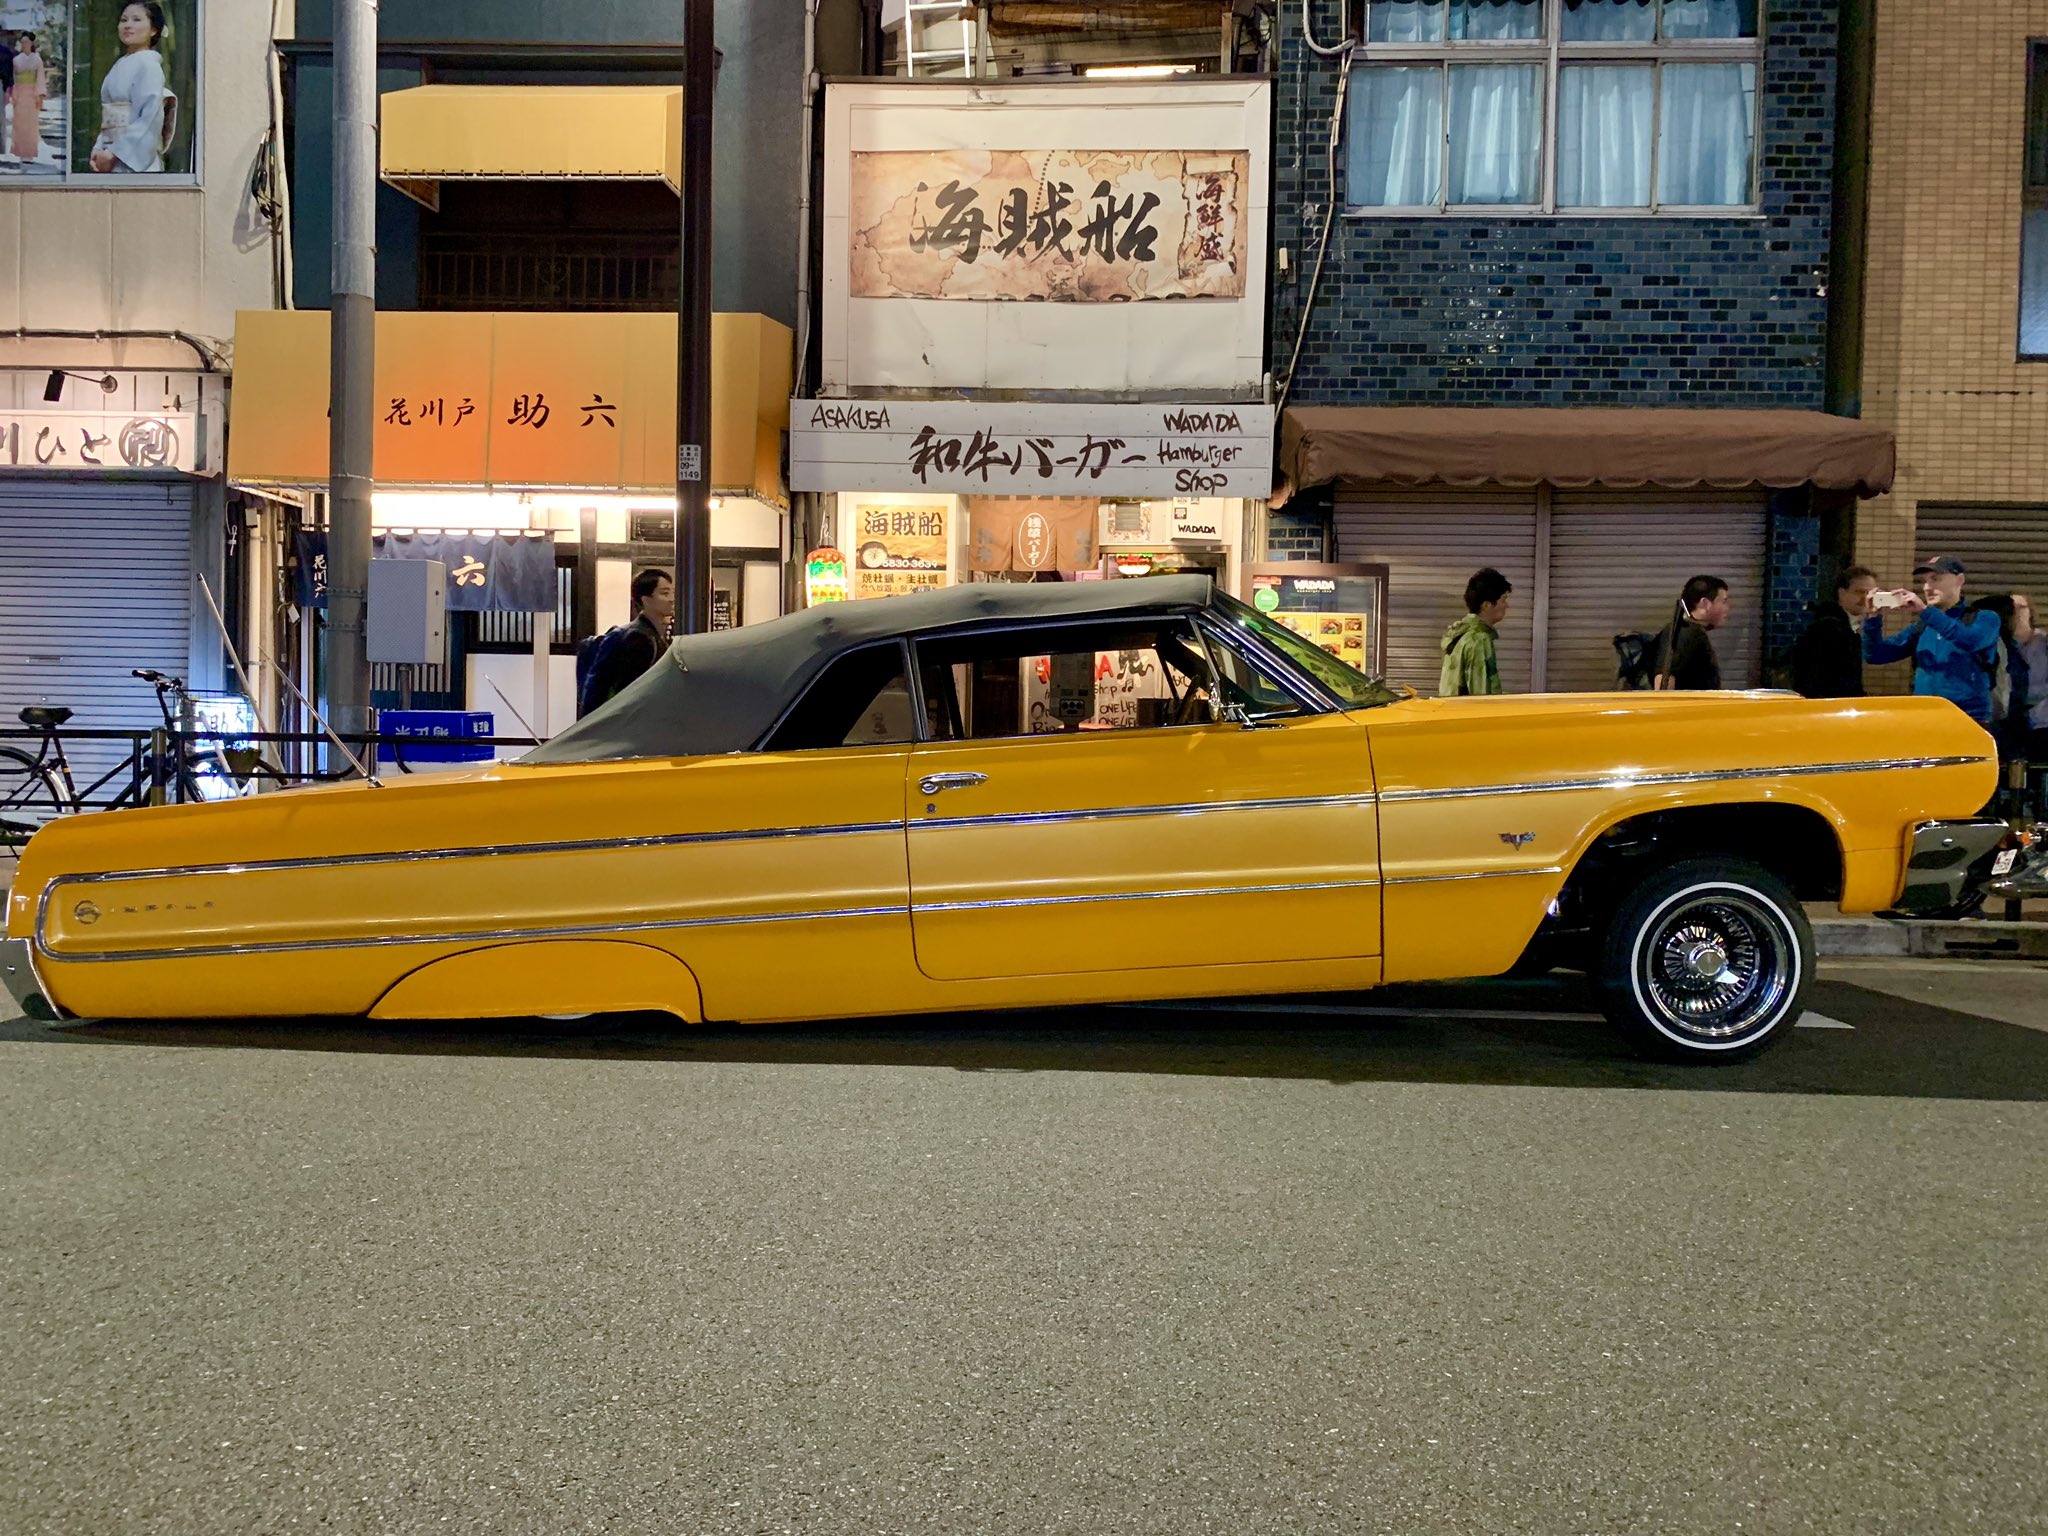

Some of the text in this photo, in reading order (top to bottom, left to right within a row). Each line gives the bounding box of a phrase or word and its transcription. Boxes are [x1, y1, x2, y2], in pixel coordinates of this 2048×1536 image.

[909, 179, 1161, 265] 海賊船
[384, 393, 618, 429] 花川戸 助六
[810, 403, 891, 430] ASAKUSA
[1163, 407, 1243, 434] WADADA
[909, 425, 1147, 484] 和牛バーガー
[1157, 438, 1243, 469] Hamburger
[680, 470, 700, 479] 1149
[1174, 468, 1229, 496] Shop
[864, 510, 943, 536] 海賊船
[1177, 524, 1217, 534] WADADA
